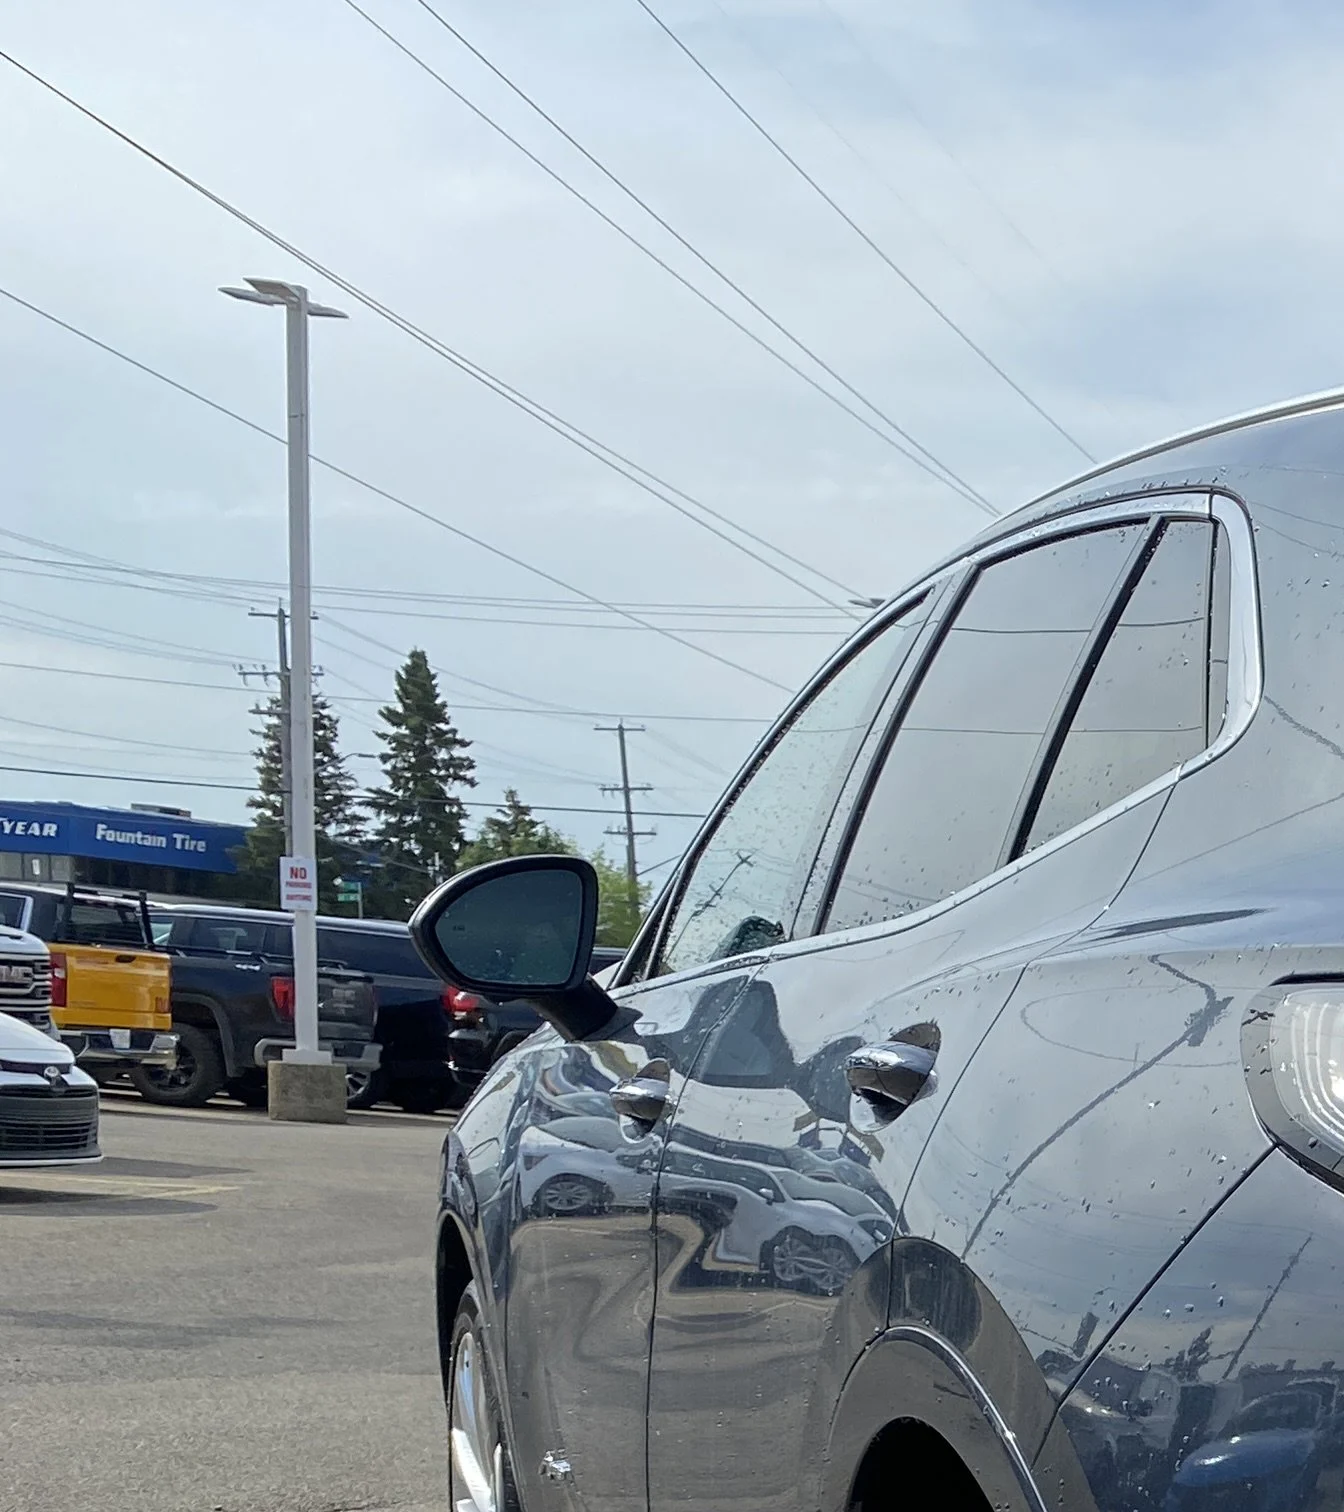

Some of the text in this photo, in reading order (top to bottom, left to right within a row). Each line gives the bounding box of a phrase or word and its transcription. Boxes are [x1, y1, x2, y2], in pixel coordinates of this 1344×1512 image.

[96, 823, 207, 853] Fountain Tire
[289, 866, 307, 879] NO
